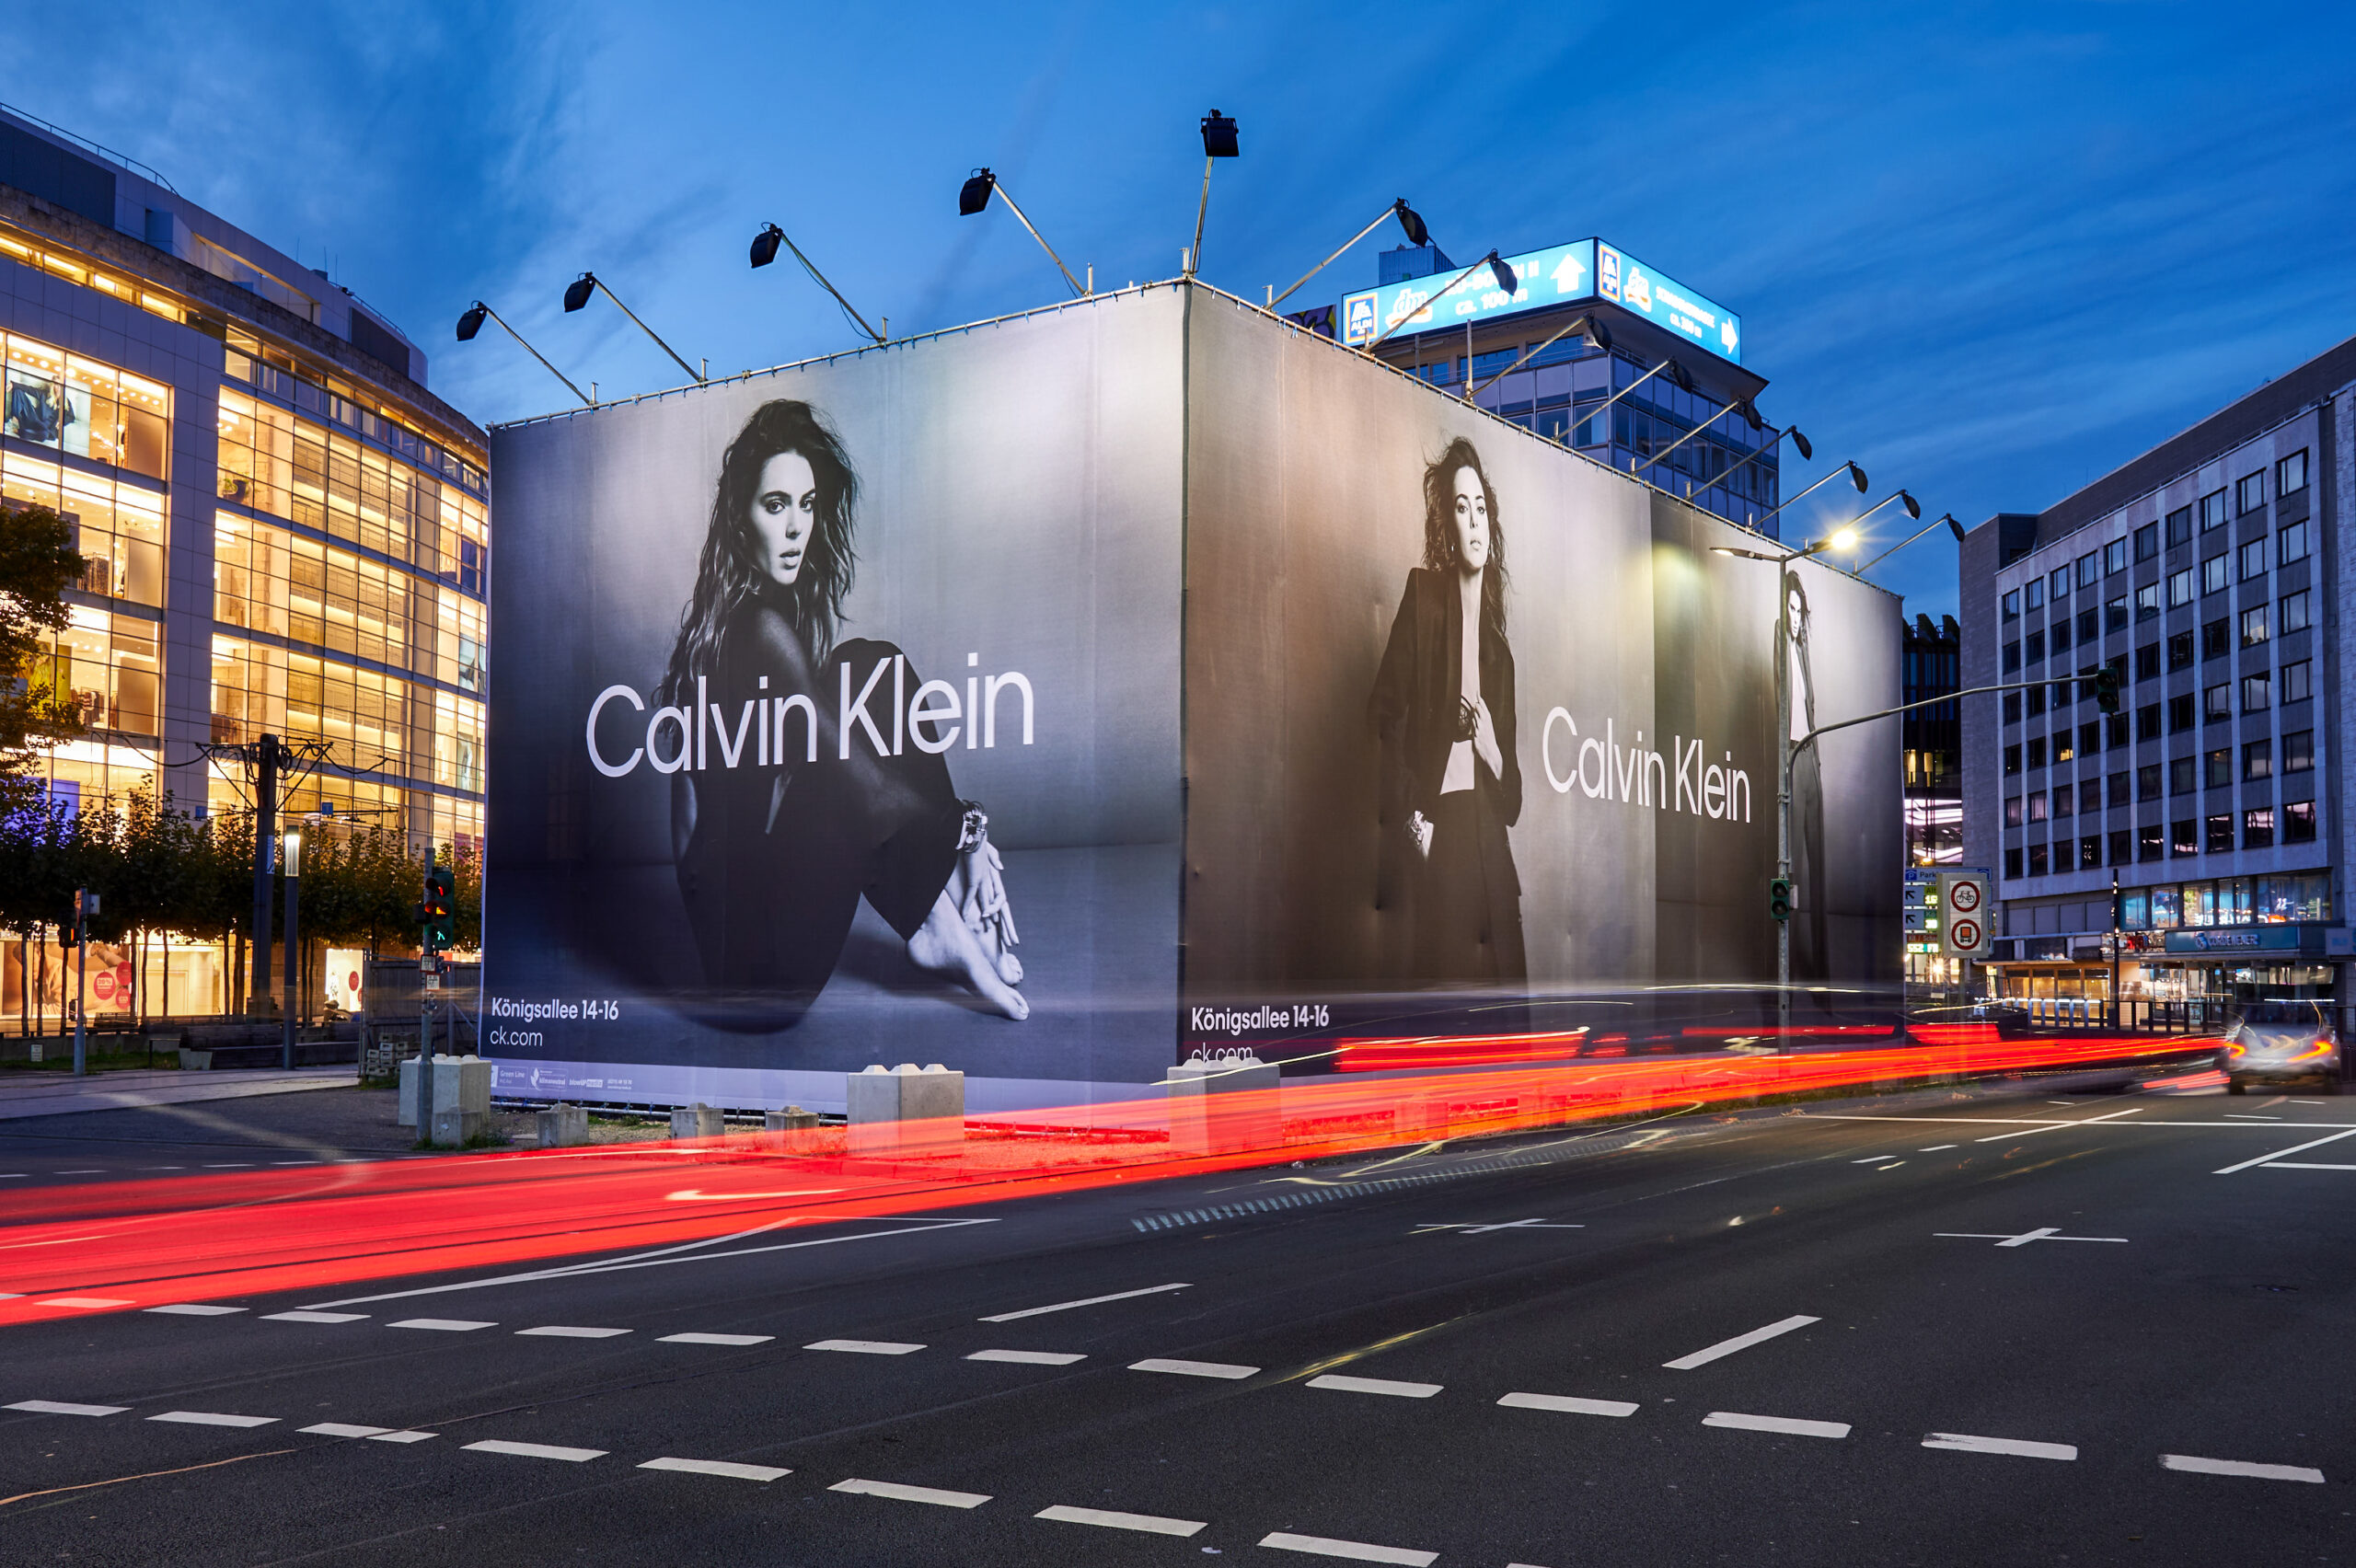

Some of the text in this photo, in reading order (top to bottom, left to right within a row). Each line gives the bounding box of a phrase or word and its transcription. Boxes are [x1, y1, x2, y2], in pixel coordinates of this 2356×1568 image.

[1444, 263, 1524, 296] KÖ-BON
[1392, 288, 1428, 317] dm
[1454, 287, 1529, 317] ca. 100 m
[1350, 317, 1373, 332] ALDI
[586, 651, 1034, 778] Calvin Klein
[1542, 706, 1750, 824] Calvin Klein
[491, 997, 619, 1023] Königsallee 14-16
[1192, 1004, 1330, 1036] Königsallee 14-16
[490, 1025, 543, 1046] ck.com
[1192, 1042, 1253, 1063] ckcom
[515, 1070, 525, 1078] Line
